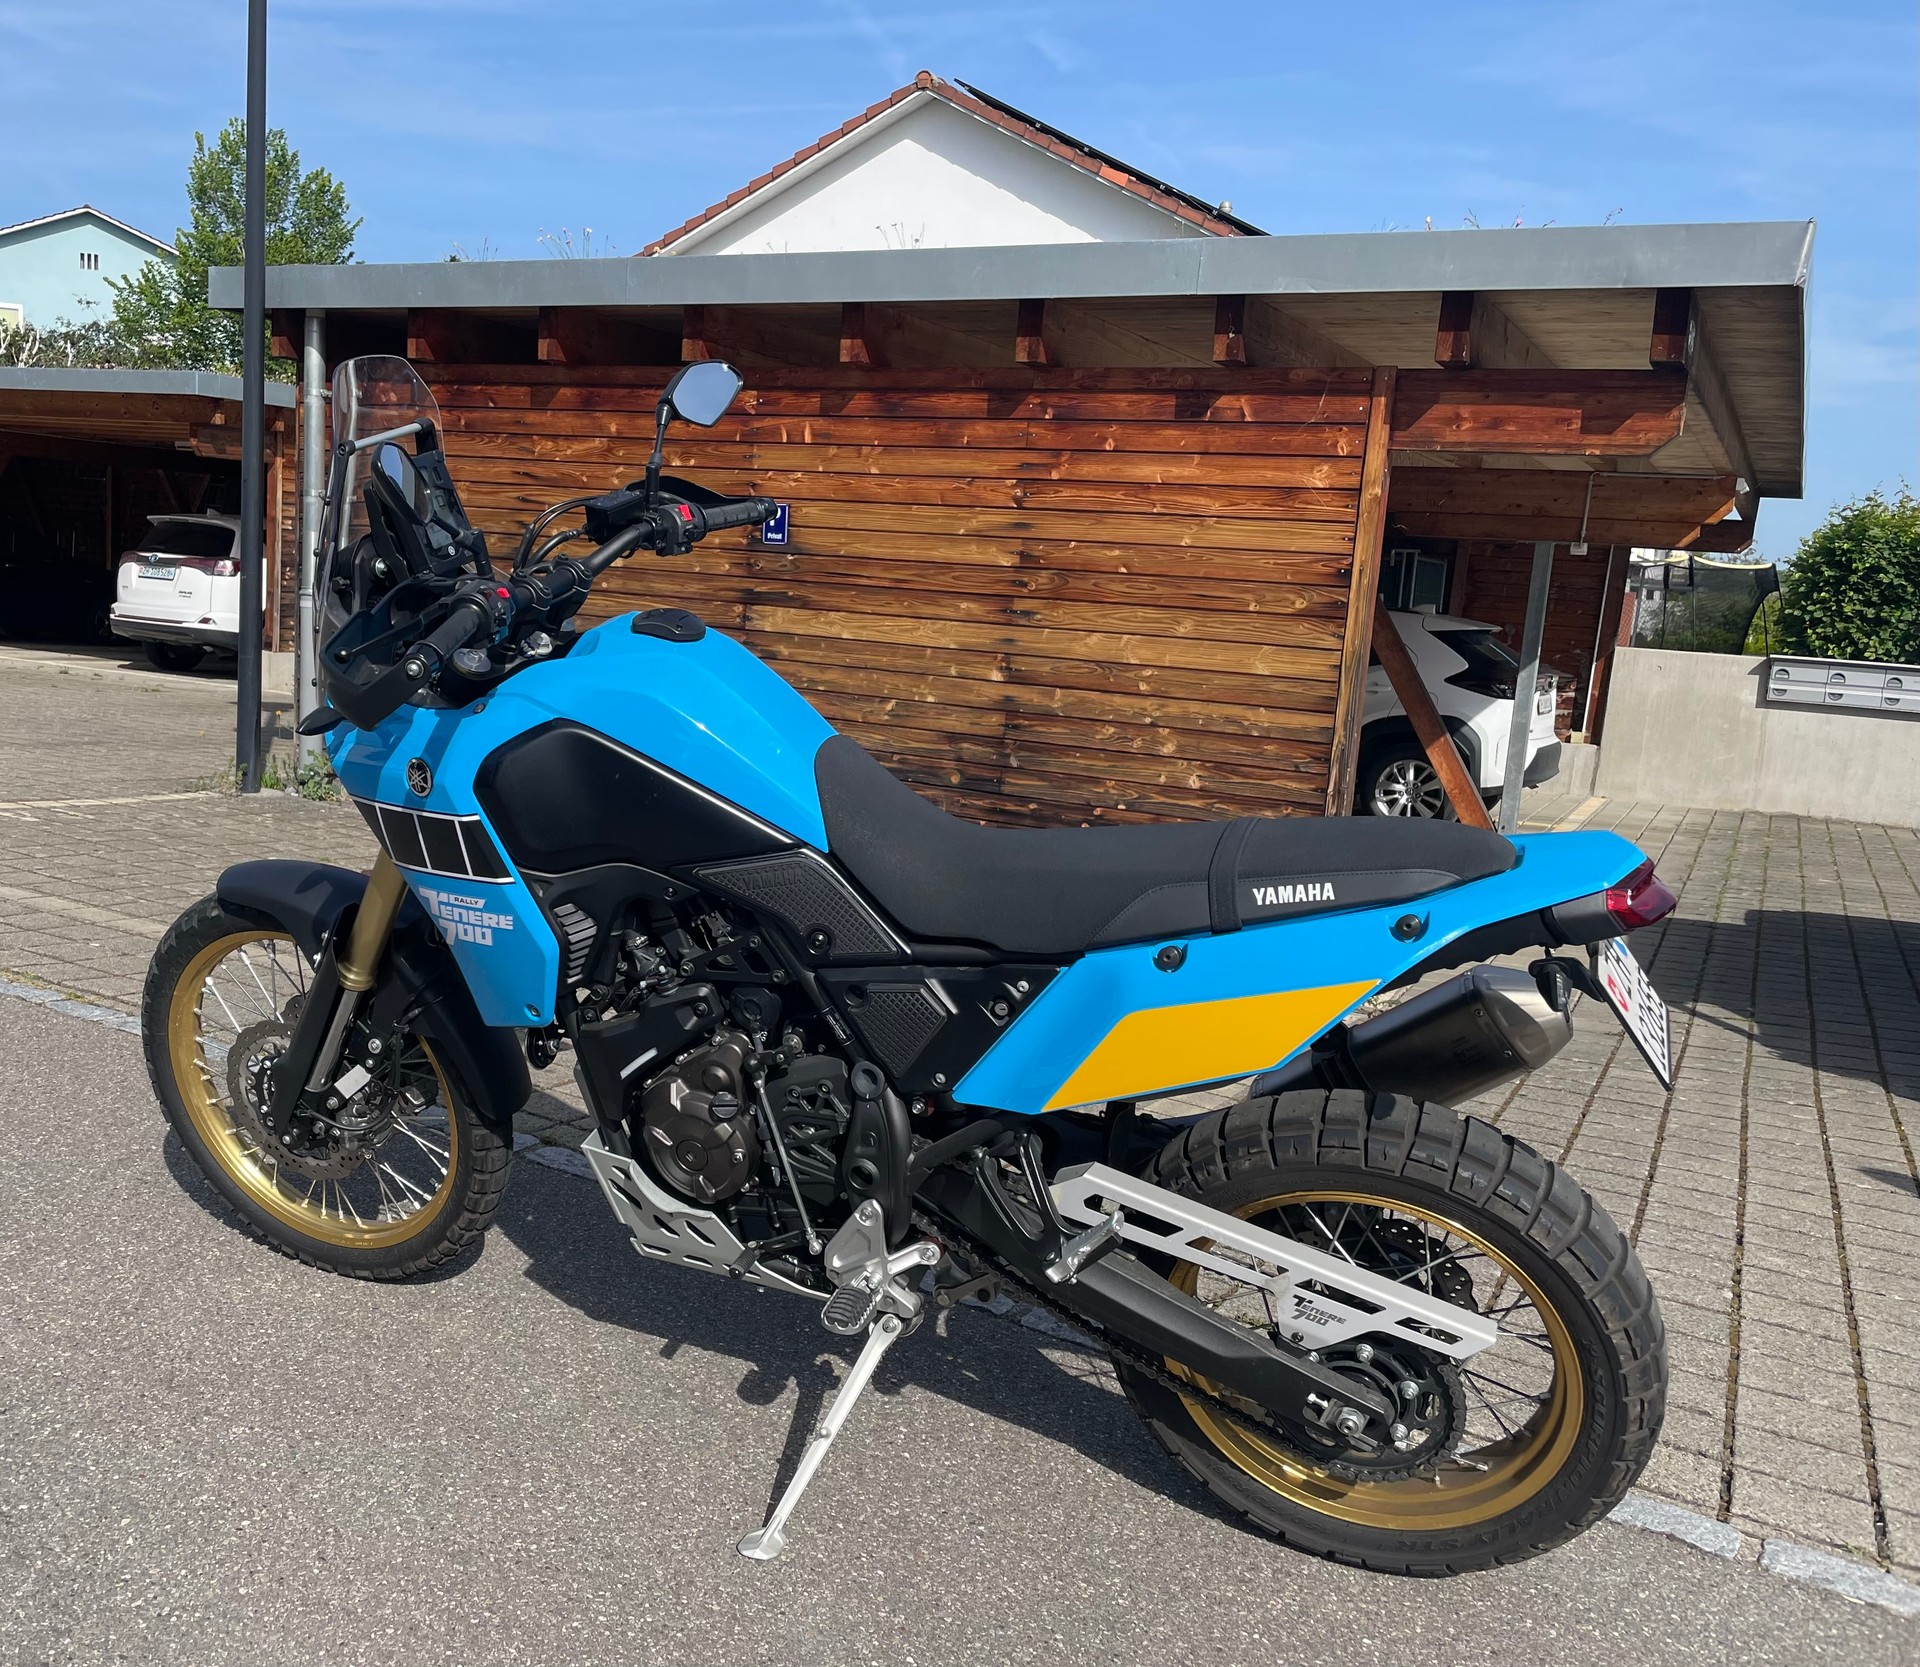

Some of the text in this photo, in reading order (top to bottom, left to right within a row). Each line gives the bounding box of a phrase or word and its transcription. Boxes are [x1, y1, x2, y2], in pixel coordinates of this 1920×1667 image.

[454, 896, 479, 905] RALLY
[1252, 882, 1335, 905] YAMAHA
[438, 918, 493, 946] 700
[1291, 1308, 1330, 1327] 700
